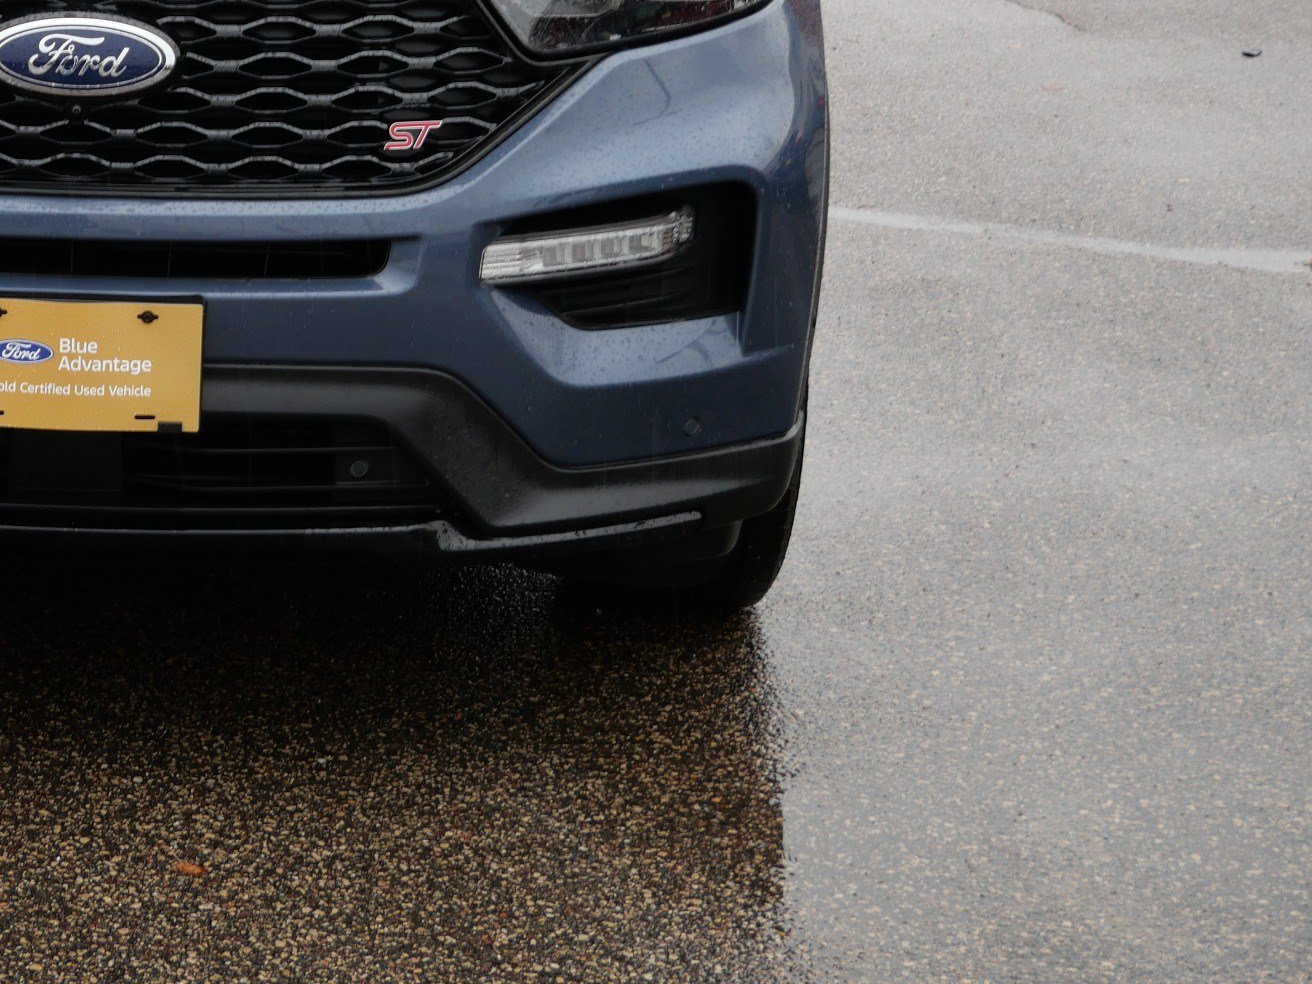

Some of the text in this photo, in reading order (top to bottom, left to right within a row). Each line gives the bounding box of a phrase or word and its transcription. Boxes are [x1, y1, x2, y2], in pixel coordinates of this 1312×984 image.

[28, 33, 130, 78] Ford
[384, 120, 443, 151] ST
[1, 341, 42, 362] Ford
[58, 337, 98, 355] Blue
[57, 355, 152, 375] Advantage
[19, 381, 71, 396] Certified
[74, 384, 105, 397] Used
[108, 384, 152, 398] Vehicle
